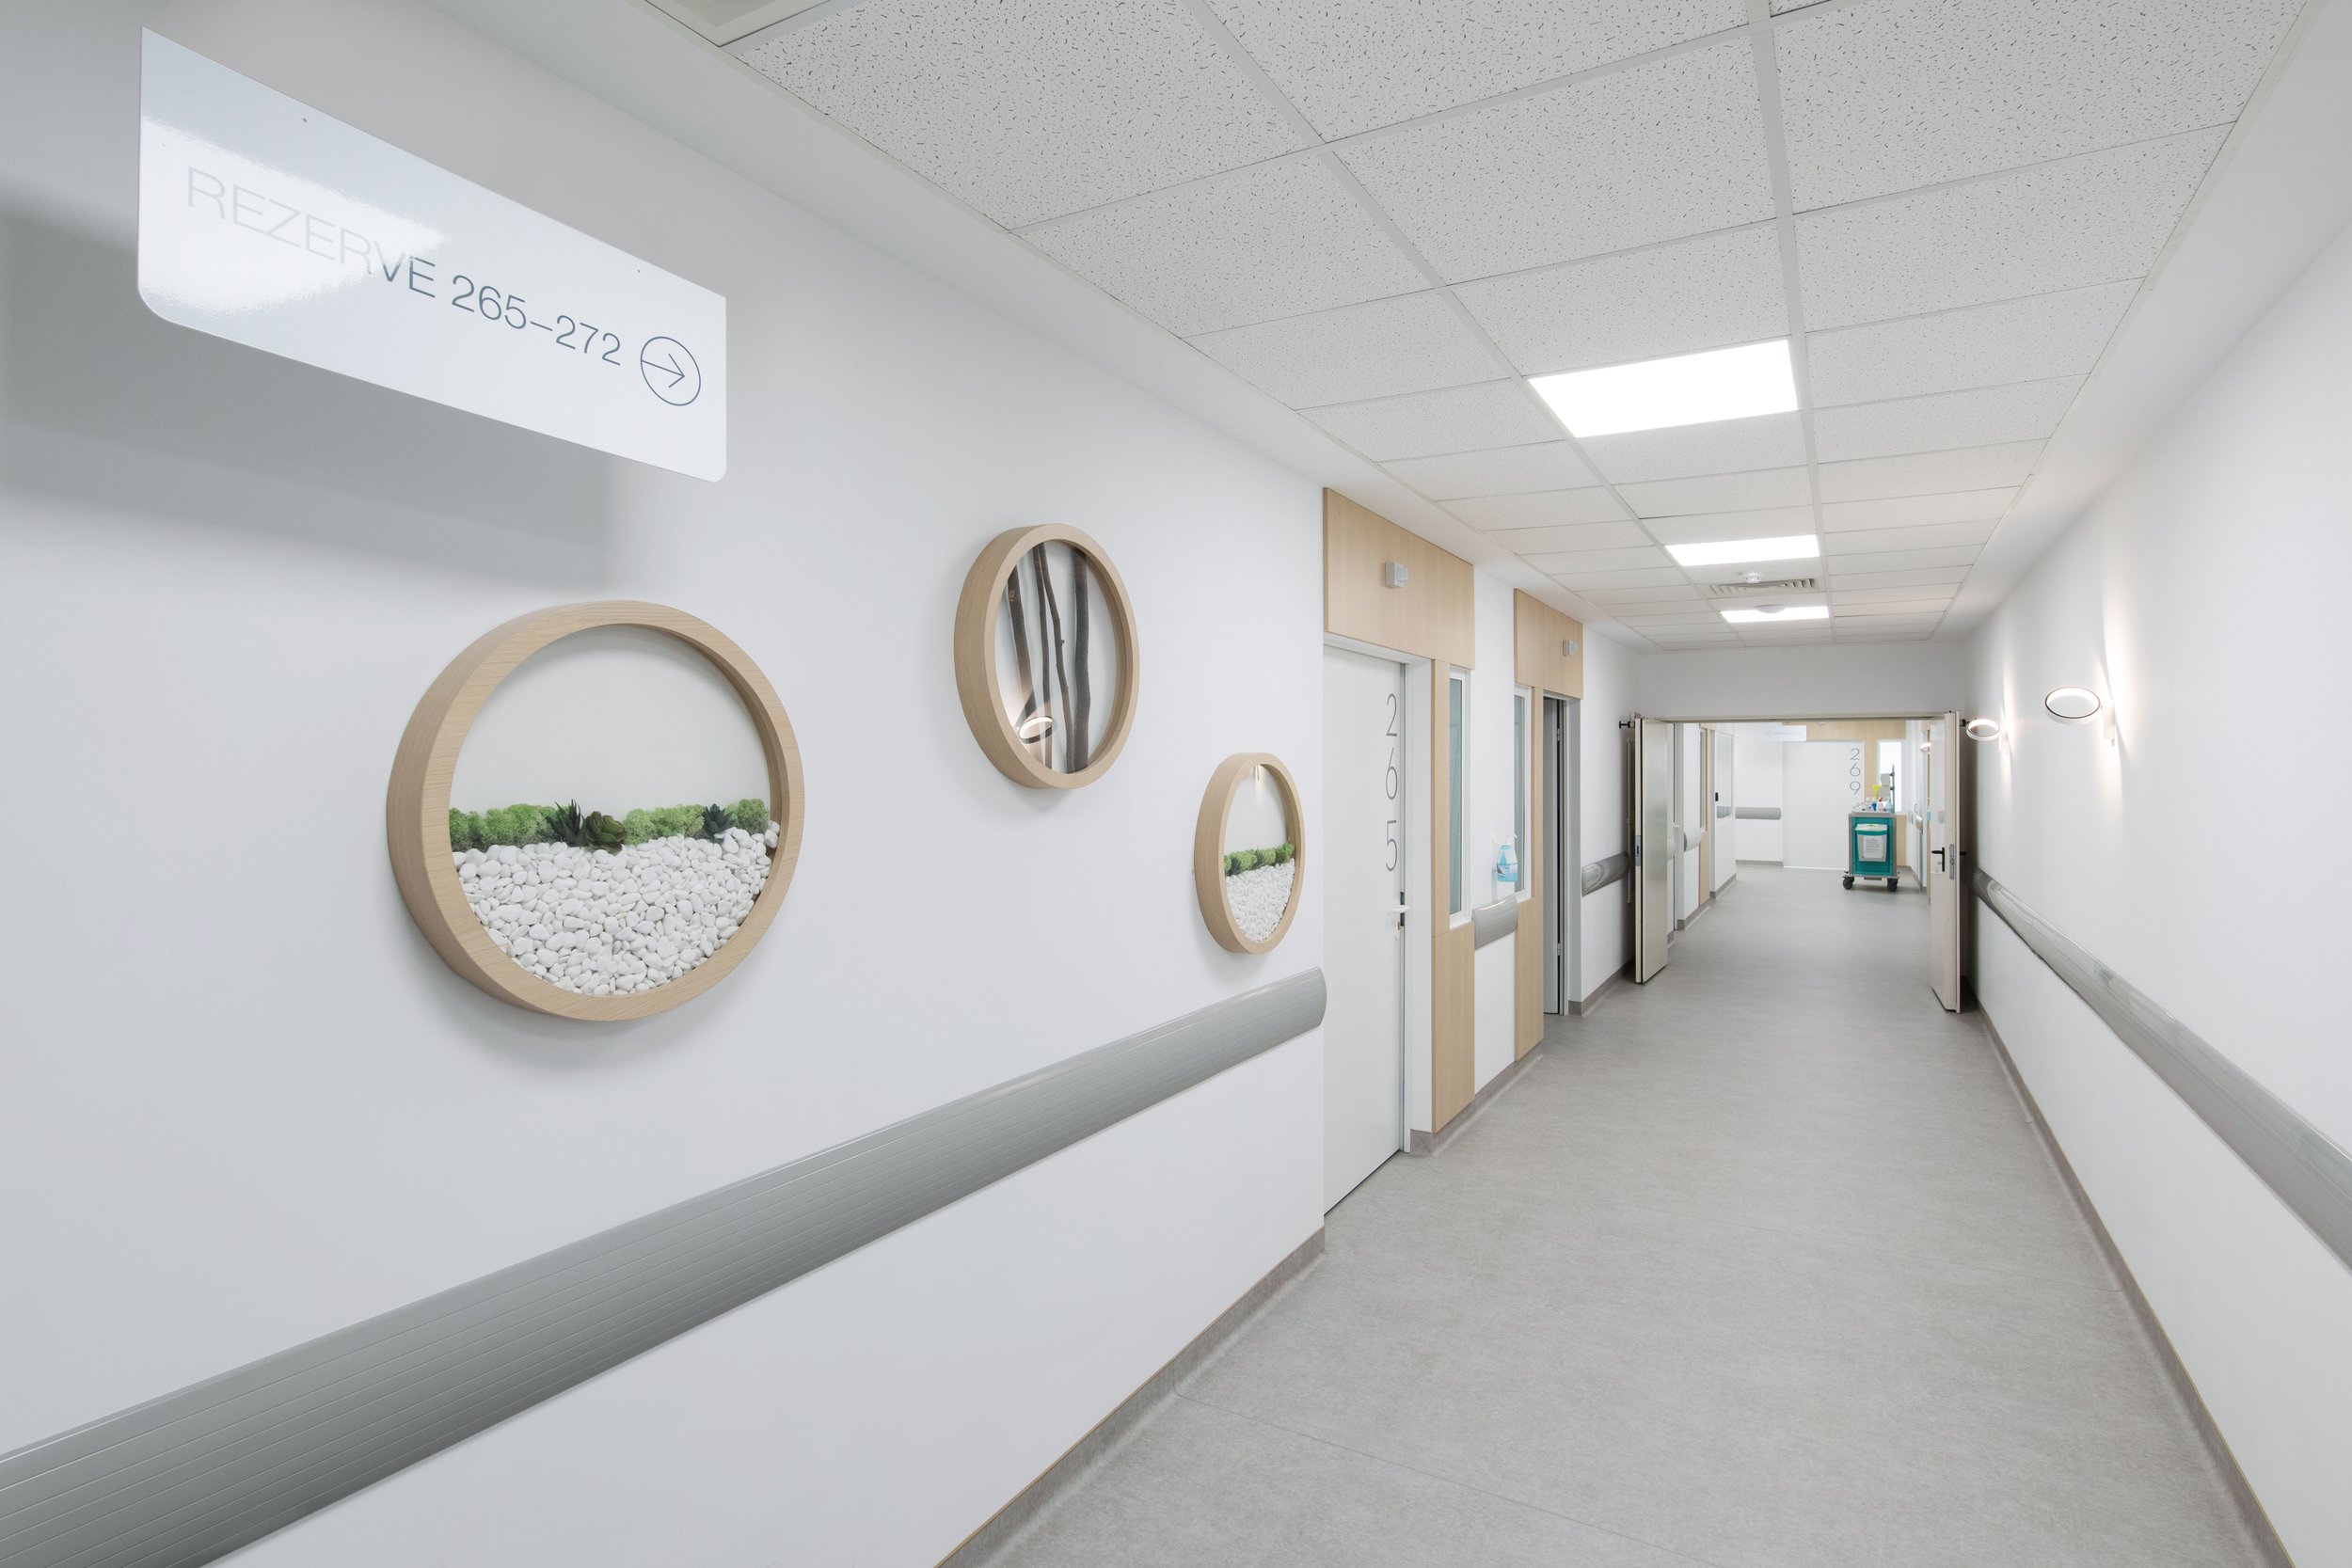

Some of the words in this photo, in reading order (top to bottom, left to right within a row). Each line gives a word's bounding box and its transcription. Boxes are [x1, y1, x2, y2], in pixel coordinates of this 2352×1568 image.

[187, 166, 437, 299] REZERVE
[1386, 693, 1398, 872] 265
[1850, 748, 1861, 796] 269
